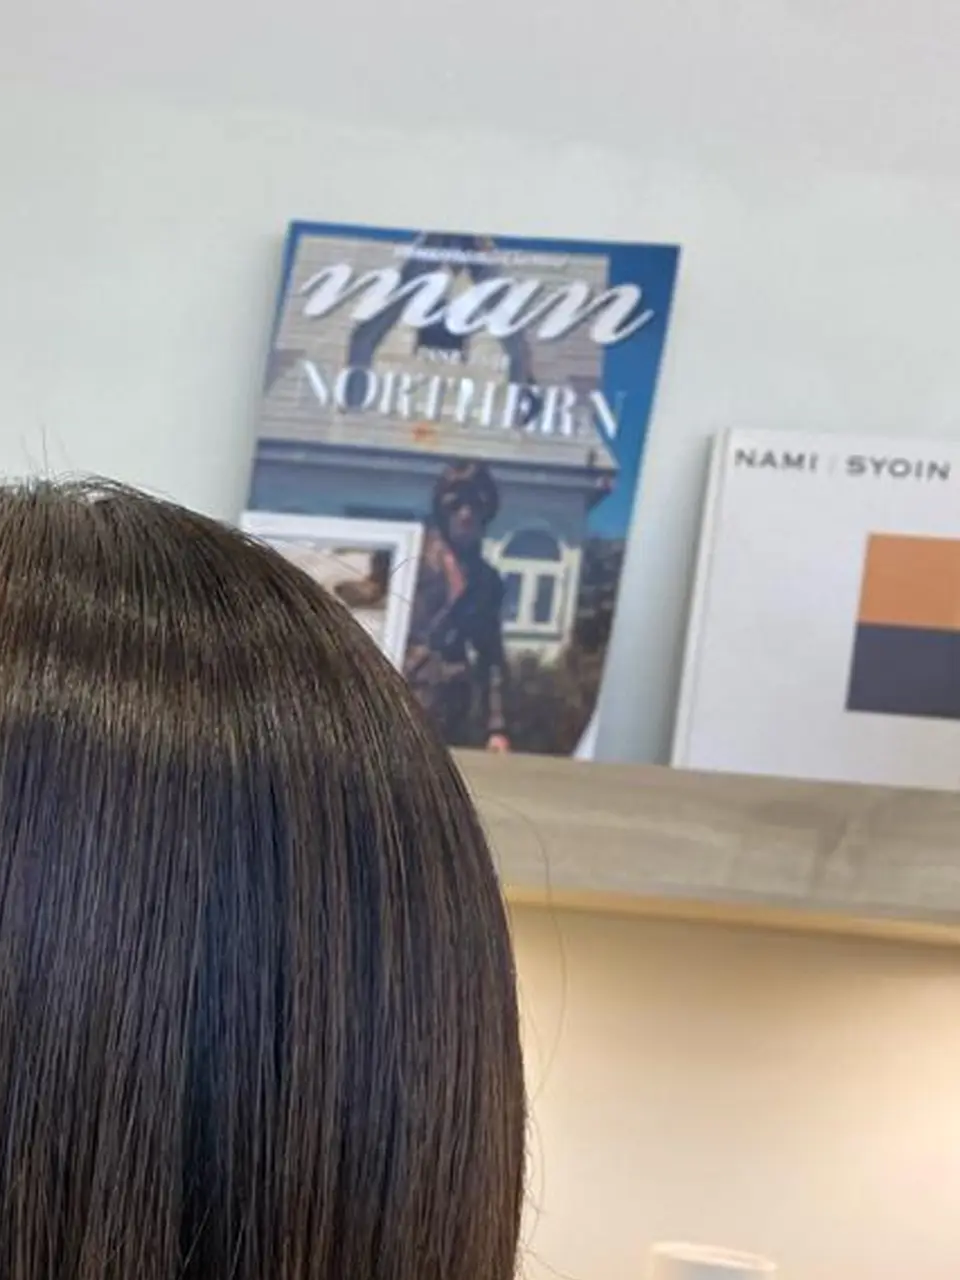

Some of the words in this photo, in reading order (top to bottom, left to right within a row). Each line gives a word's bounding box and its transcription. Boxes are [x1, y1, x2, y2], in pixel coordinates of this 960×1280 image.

[301, 260, 654, 344] man
[299, 359, 626, 439] NORTHERN
[734, 449, 819, 473] NAMI
[845, 454, 951, 481] SYOIN
